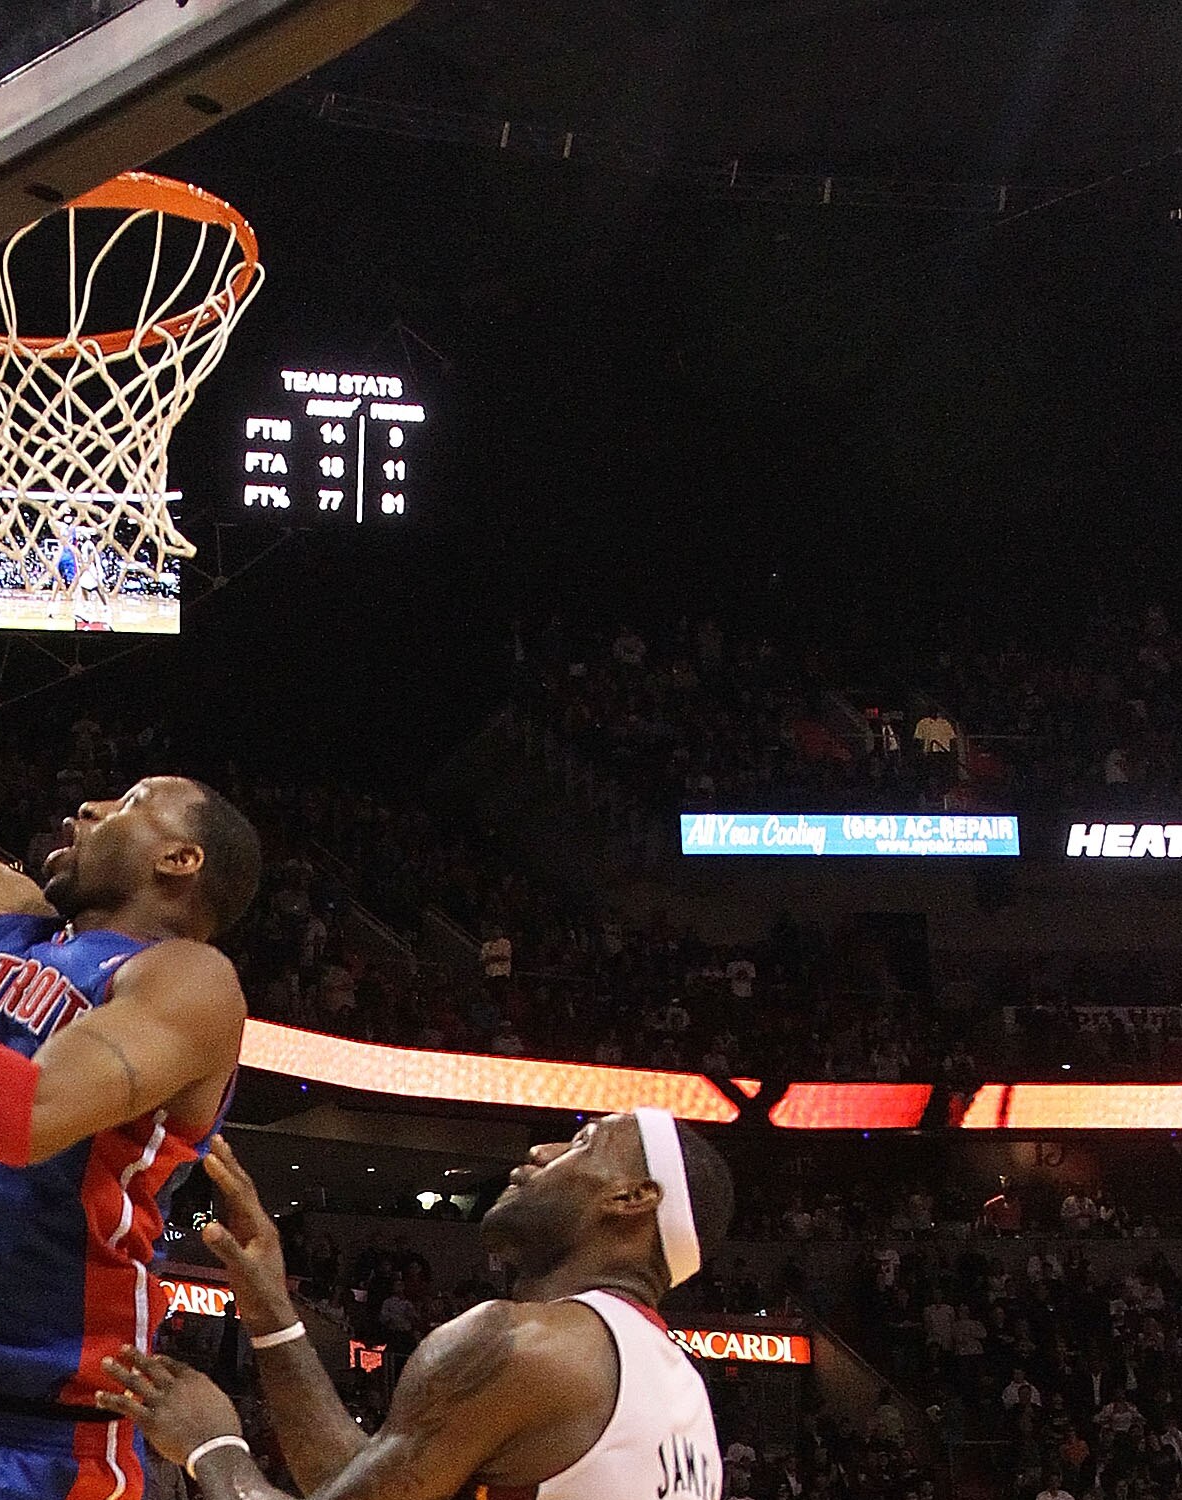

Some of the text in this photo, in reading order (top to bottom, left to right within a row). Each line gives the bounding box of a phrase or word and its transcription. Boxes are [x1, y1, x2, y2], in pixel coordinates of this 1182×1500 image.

[280, 370, 403, 398] TEAM STATS
[245, 417, 292, 442] FTM
[319, 422, 346, 444] 14
[244, 451, 406, 481] FTA 18 11
[243, 483, 291, 509] FT%
[317, 489, 345, 511] 77
[686, 814, 1014, 854] All Year Cooling (954) AC-REPAIR
[1066, 823, 1182, 858] HEAT
